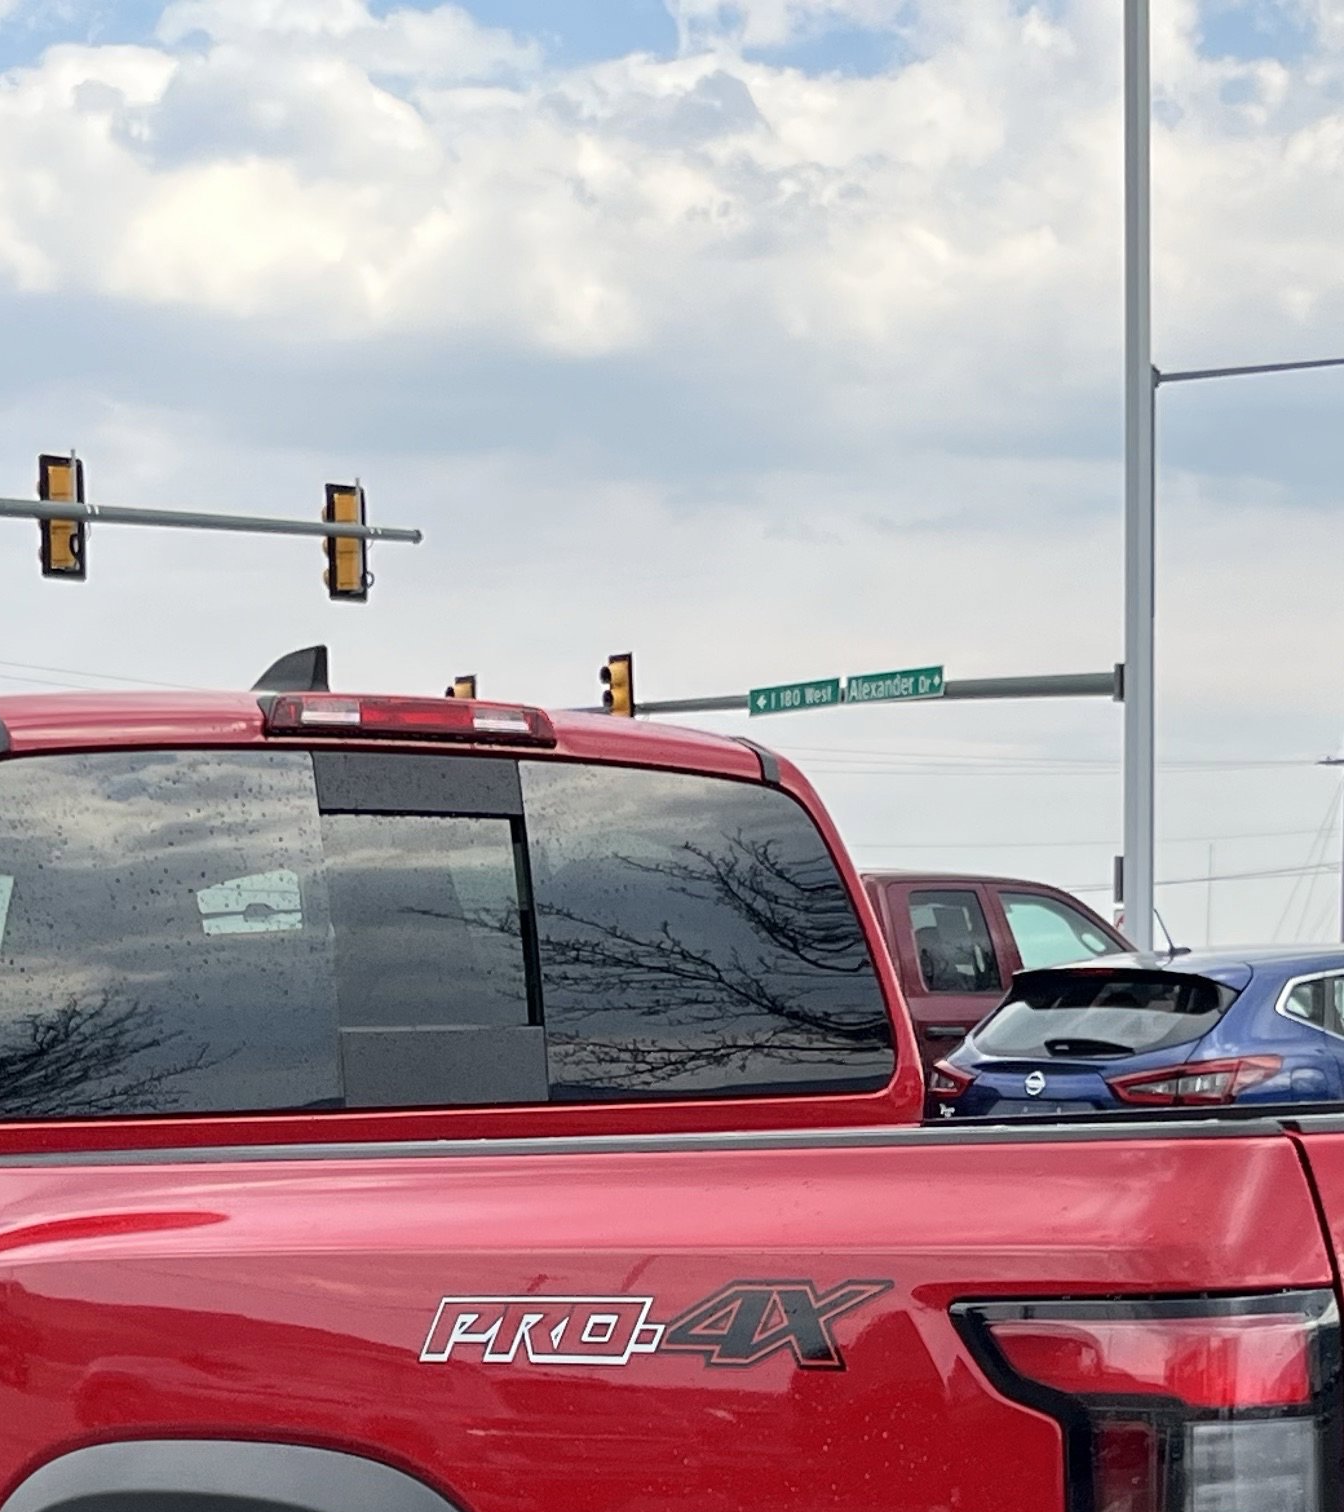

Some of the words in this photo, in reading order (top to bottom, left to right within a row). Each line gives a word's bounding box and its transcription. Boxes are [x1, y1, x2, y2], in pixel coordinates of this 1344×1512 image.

[780, 689, 801, 708] 180
[804, 685, 832, 704] West
[848, 674, 914, 700] Alexander
[918, 676, 931, 693] Dr
